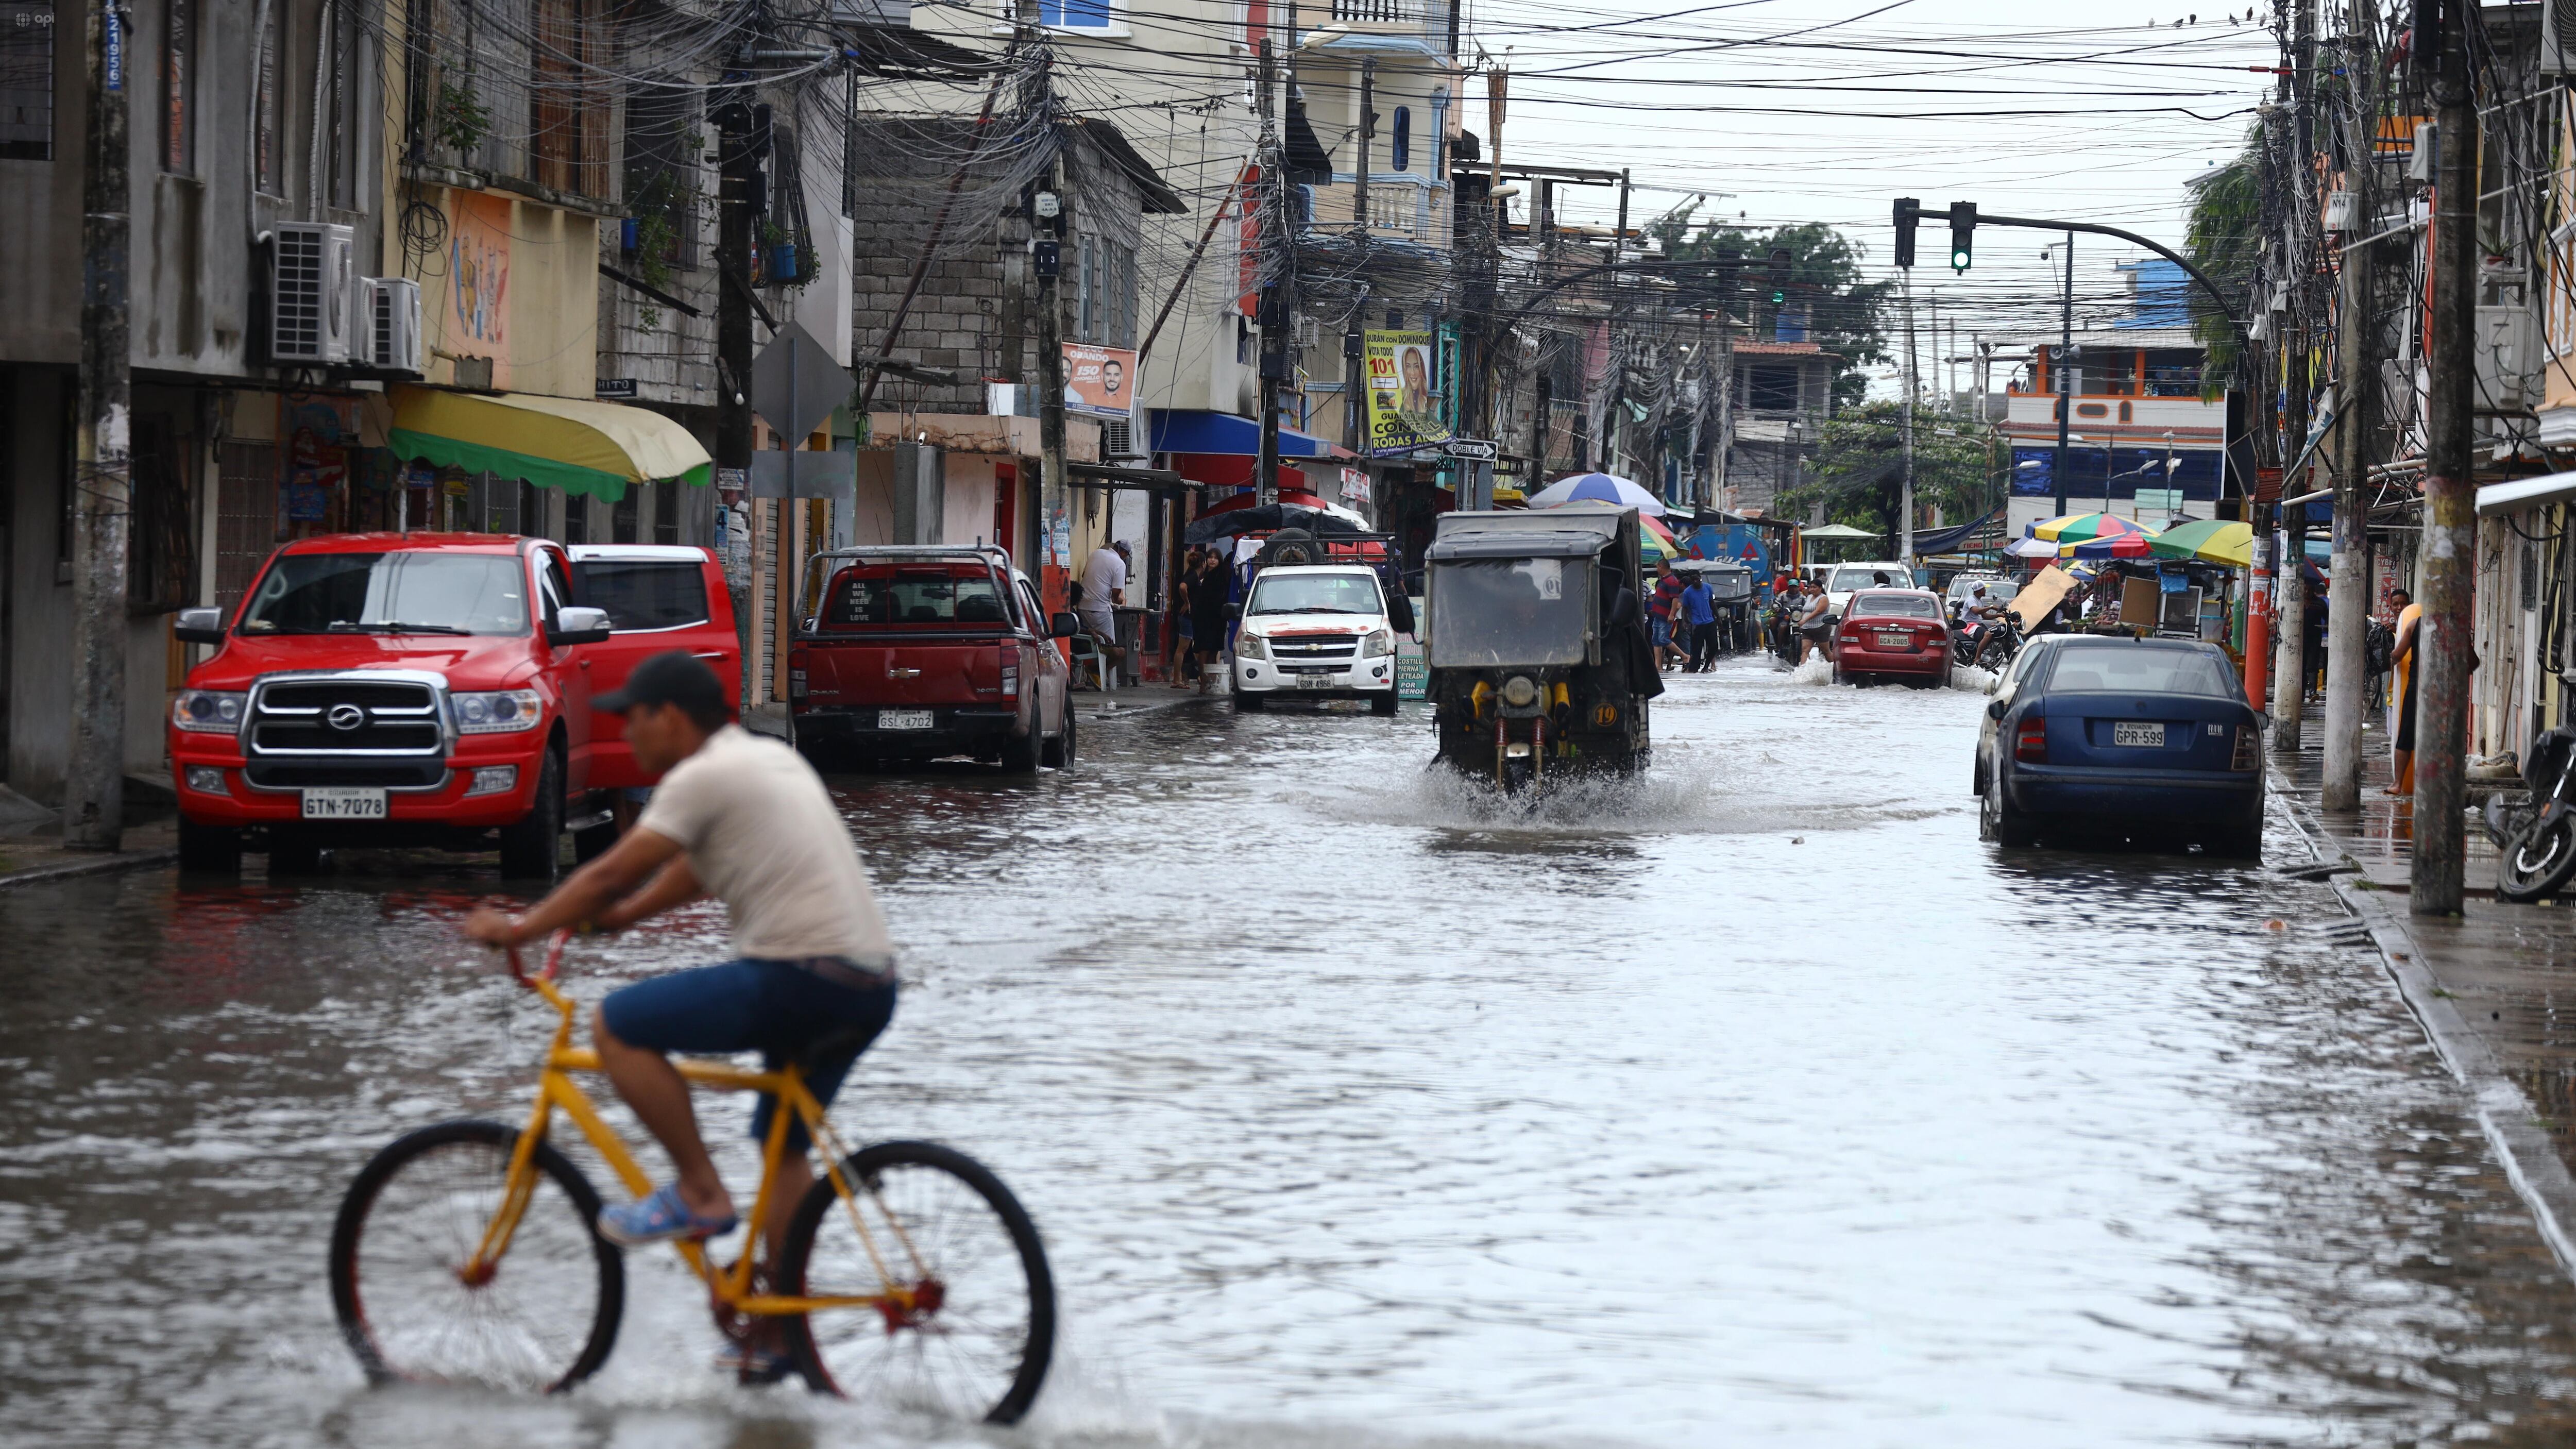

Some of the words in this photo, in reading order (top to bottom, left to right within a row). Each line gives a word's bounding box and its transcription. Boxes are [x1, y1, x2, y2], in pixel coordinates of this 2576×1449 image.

[1367, 332, 1385, 342] DURÁN
[1398, 334, 1430, 344] DOMINIQUE
[1070, 351, 1109, 362] OBANDO
[1368, 346, 1380, 356] VOTA
[1381, 347, 1393, 356] TODO
[1077, 365, 1099, 376] 150
[1369, 358, 1396, 374] 101
[1373, 436, 1412, 448] RODAS
[1453, 445, 1475, 453] DOBLE
[717, 511, 726, 529] 4
[1598, 707, 1615, 723] 19
[881, 717, 931, 727] GSL-4702
[2116, 730, 2163, 744] GPR-599
[306, 799, 382, 814] GTN-7078
